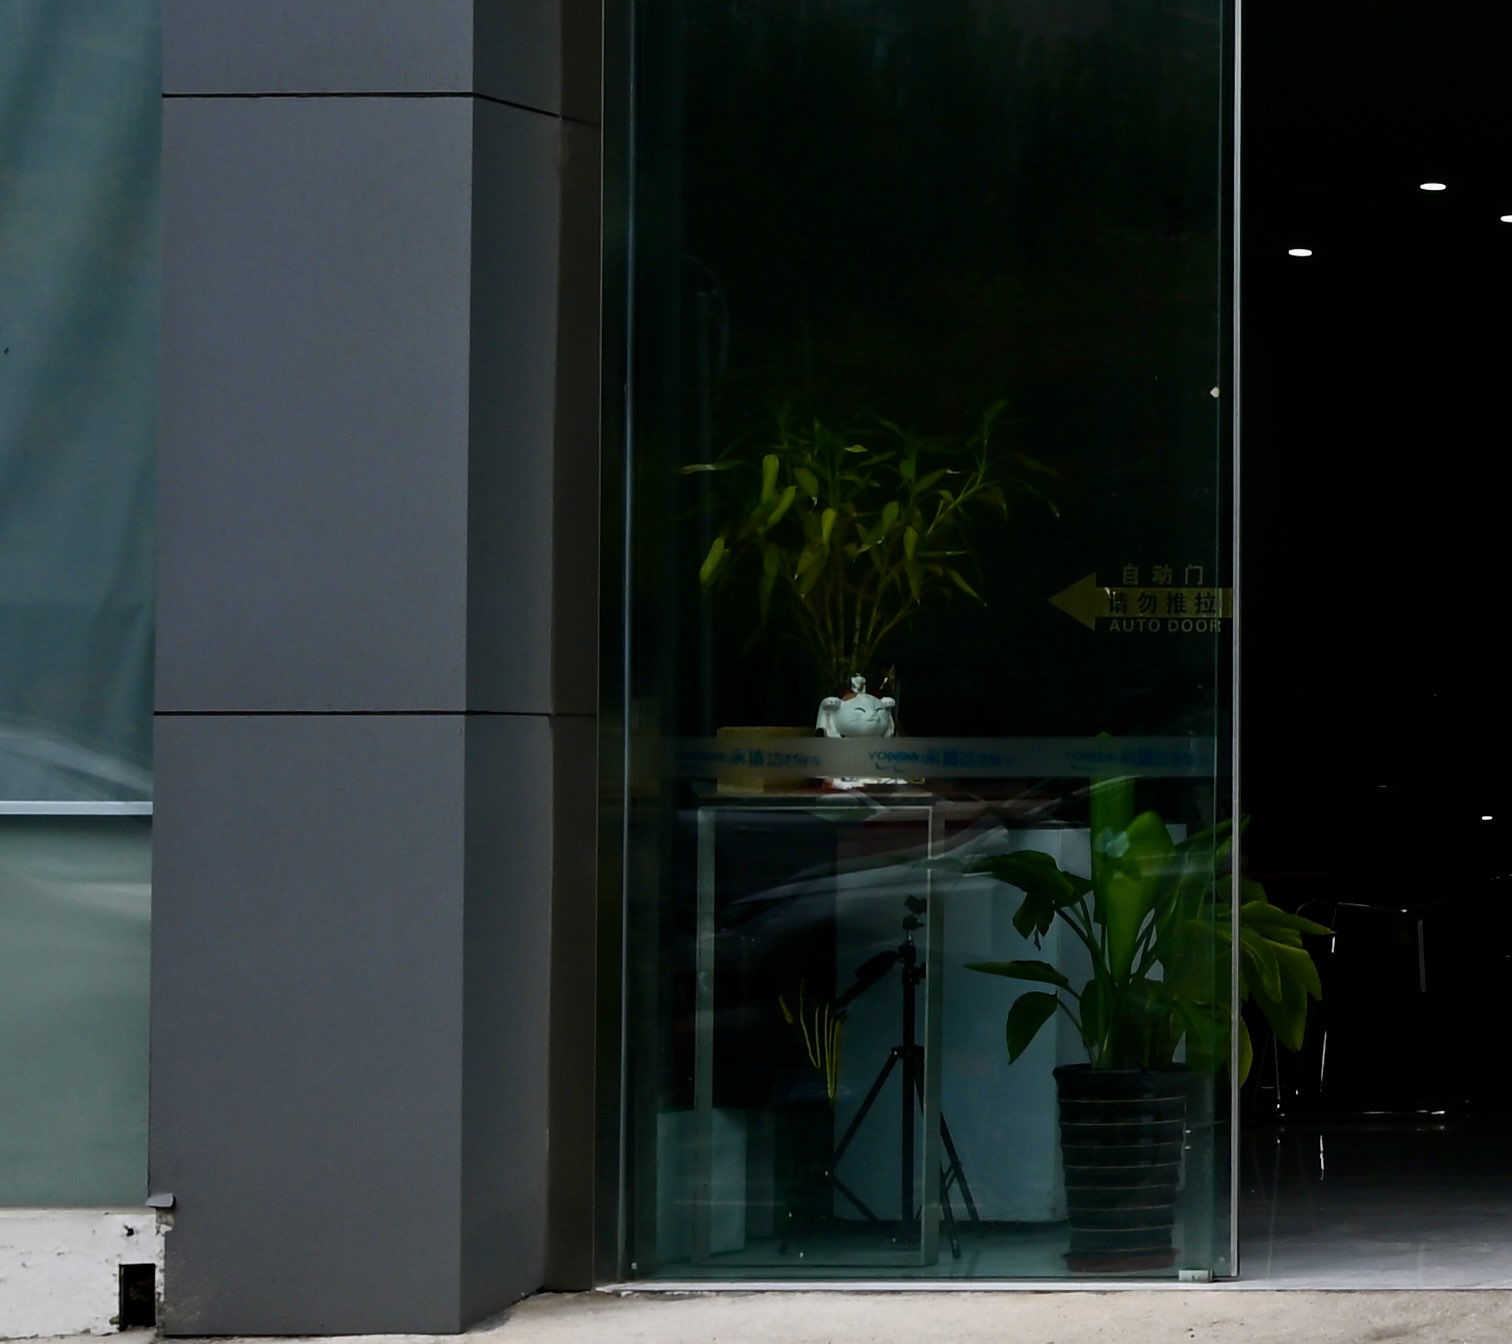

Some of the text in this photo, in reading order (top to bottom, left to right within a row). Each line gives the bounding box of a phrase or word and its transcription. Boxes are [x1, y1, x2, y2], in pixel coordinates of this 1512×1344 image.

[1121, 562, 1204, 586] 自动门
[1107, 591, 1217, 615] 请勿推拉
[1108, 618, 1222, 633] AUTO DOOR
